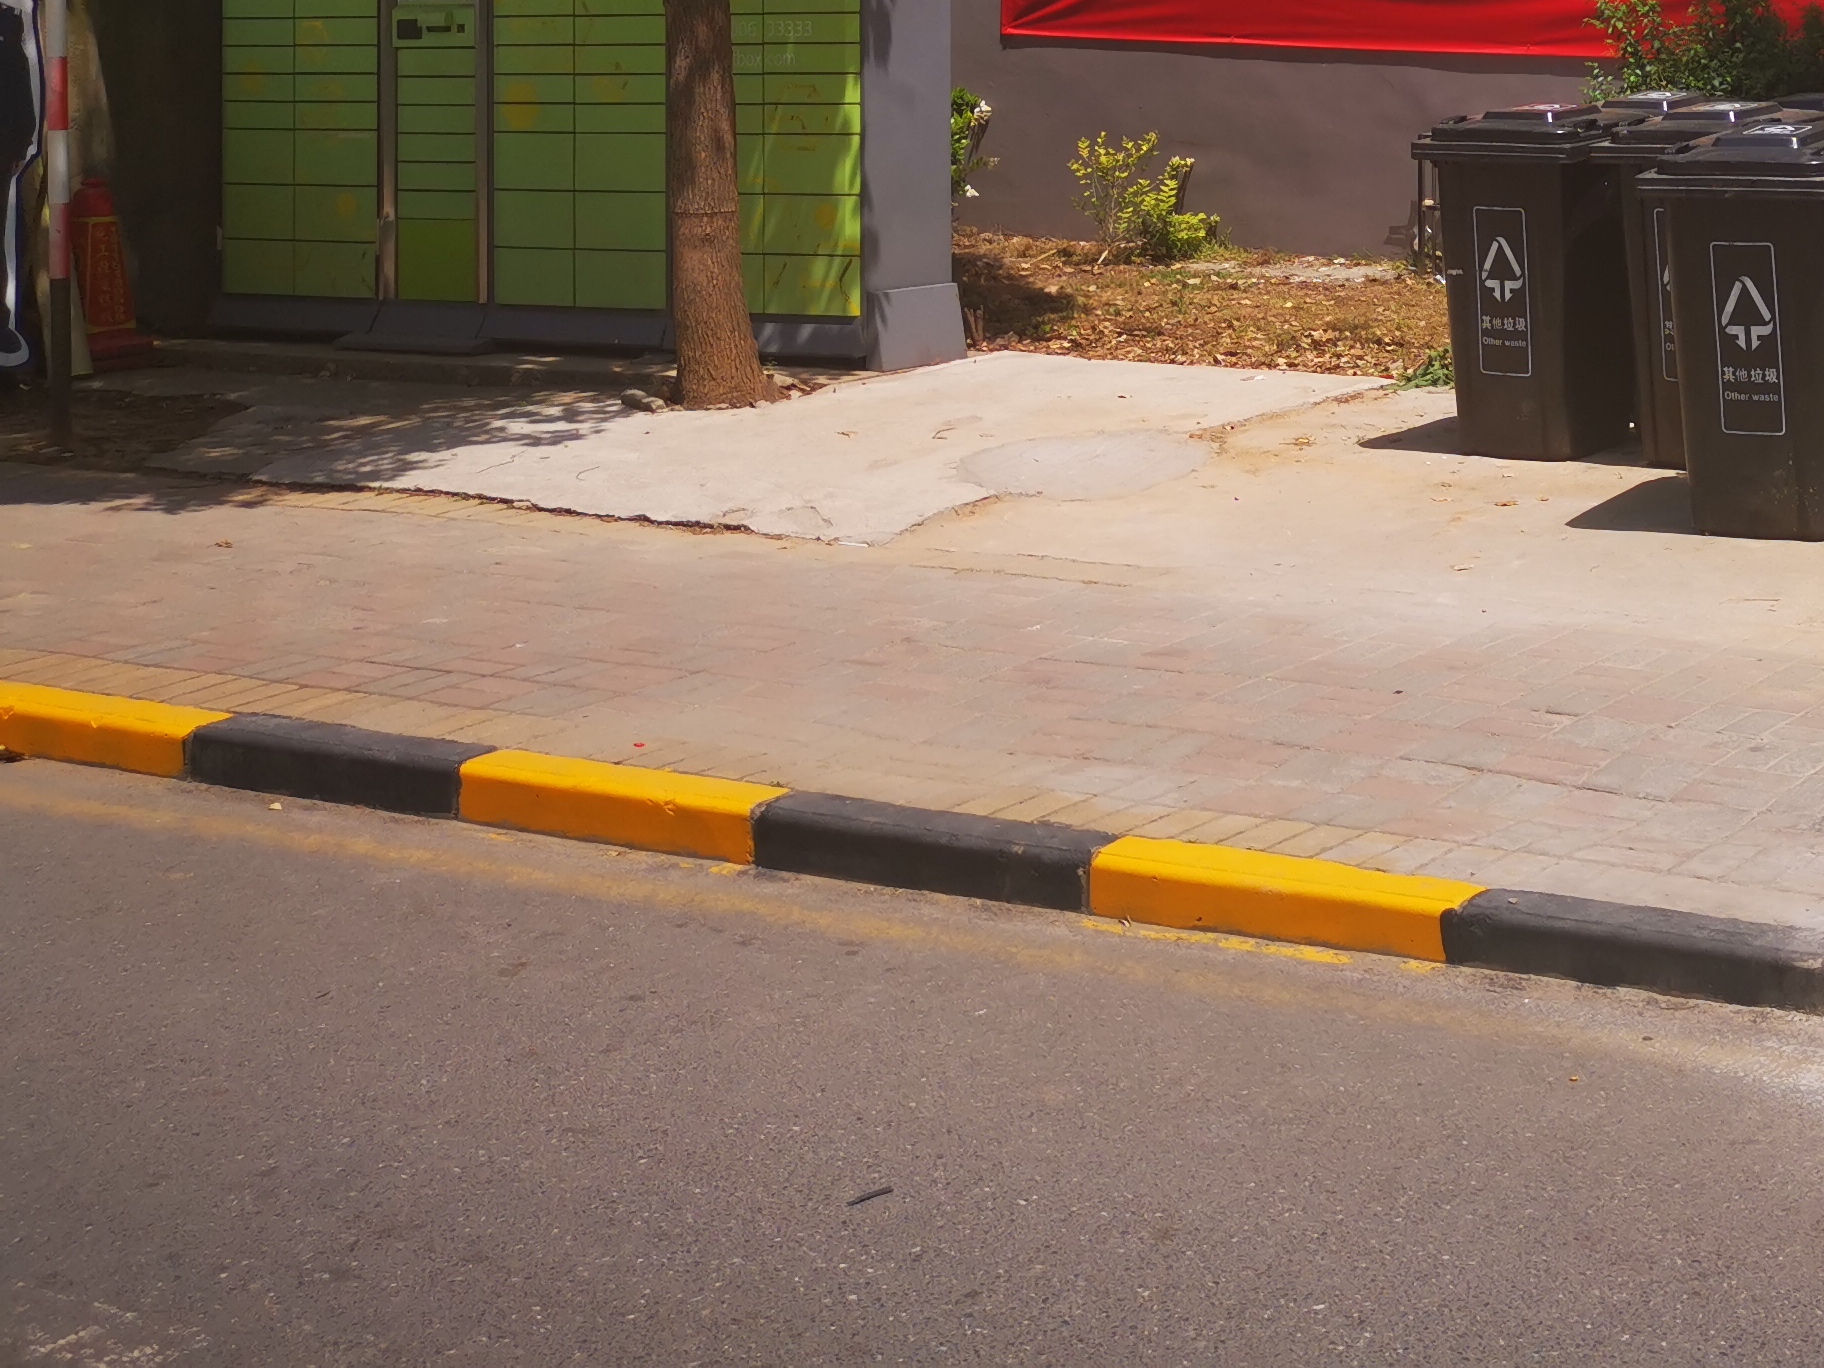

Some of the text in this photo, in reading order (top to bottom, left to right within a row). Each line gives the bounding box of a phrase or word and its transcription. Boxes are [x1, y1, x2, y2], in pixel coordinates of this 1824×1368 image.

[1482, 315, 1527, 332] 其他垃圾
[1482, 336, 1527, 348] Other waste
[1722, 366, 1779, 384] 其他垃圾
[1724, 390, 1779, 402] Other waste
